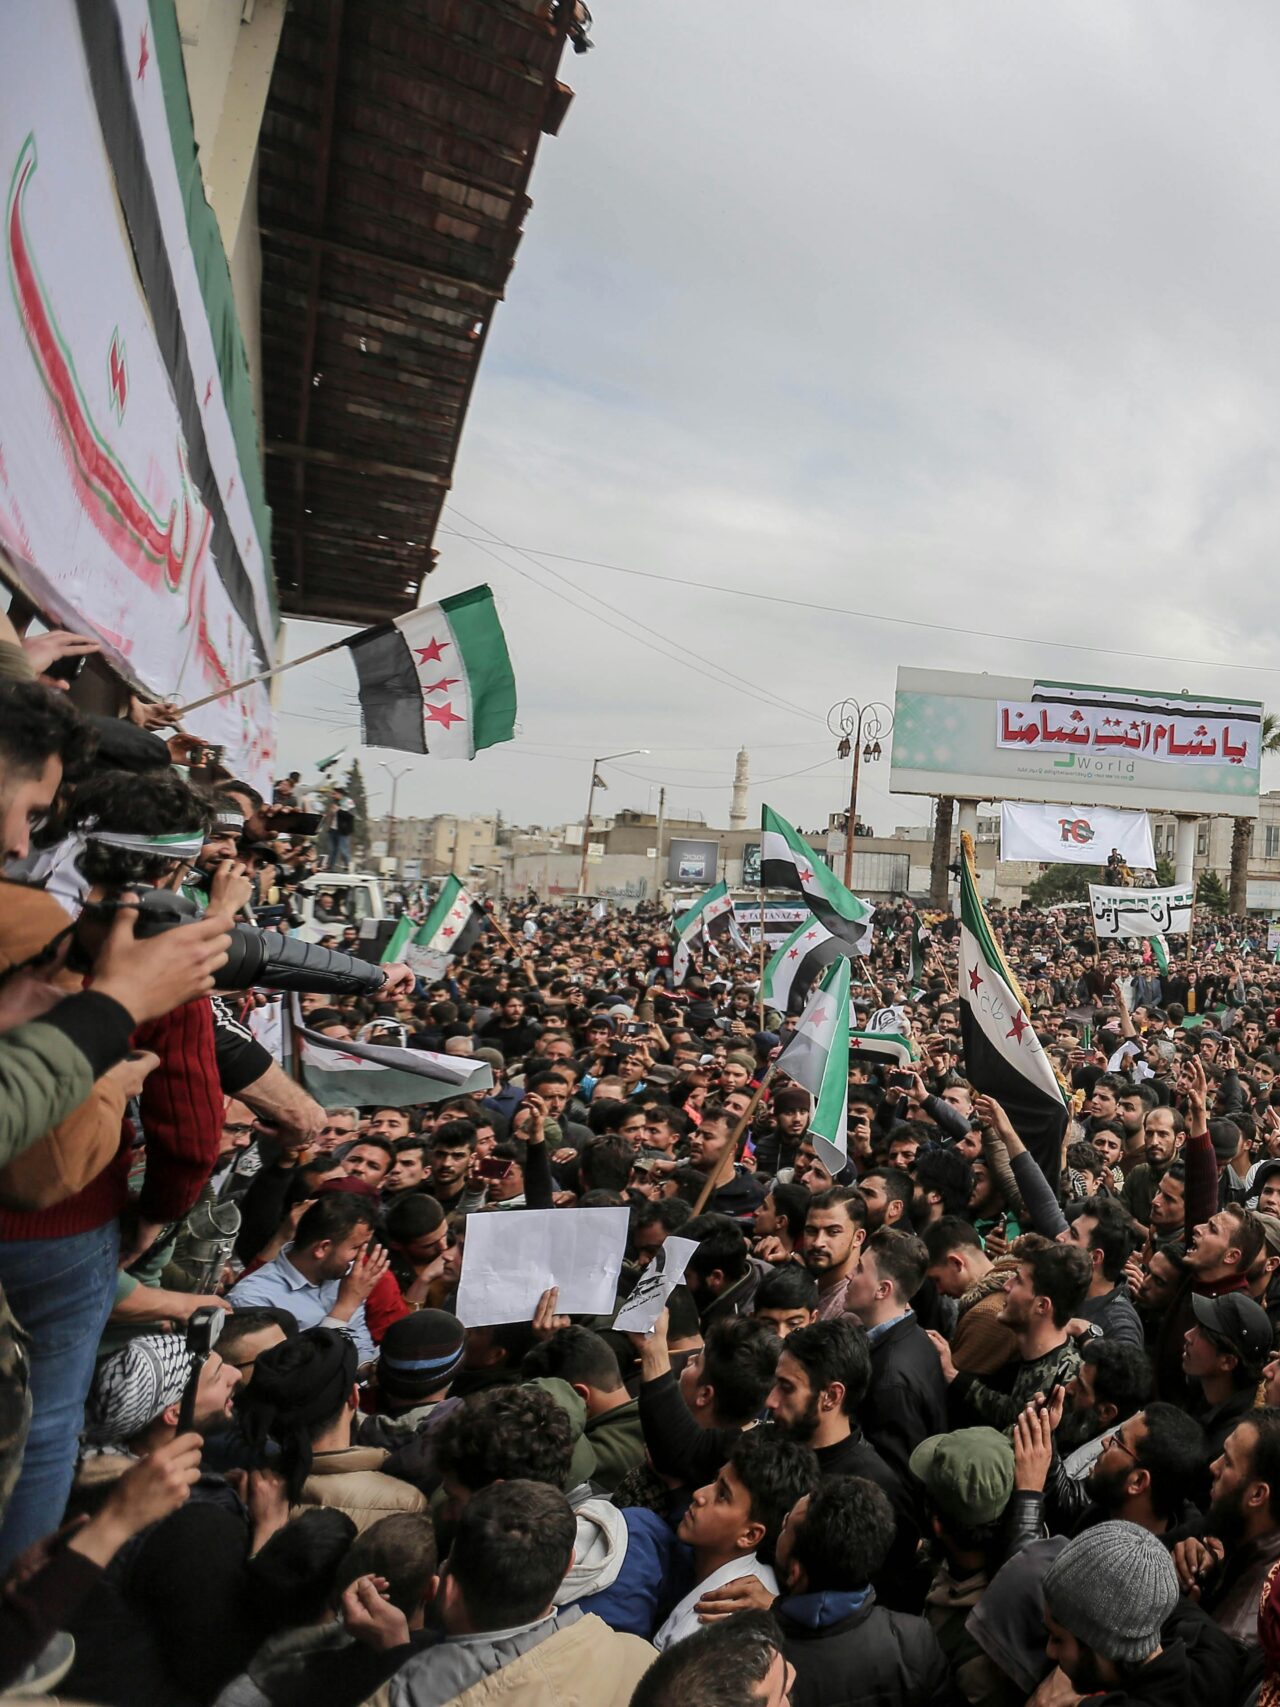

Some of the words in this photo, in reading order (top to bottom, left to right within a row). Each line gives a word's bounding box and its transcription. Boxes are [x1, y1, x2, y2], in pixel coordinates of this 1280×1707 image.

[1001, 708, 1091, 746] شامنا
[1153, 723, 1217, 757] شام
[1221, 725, 1248, 764] يا
[1077, 757, 1135, 773] World
